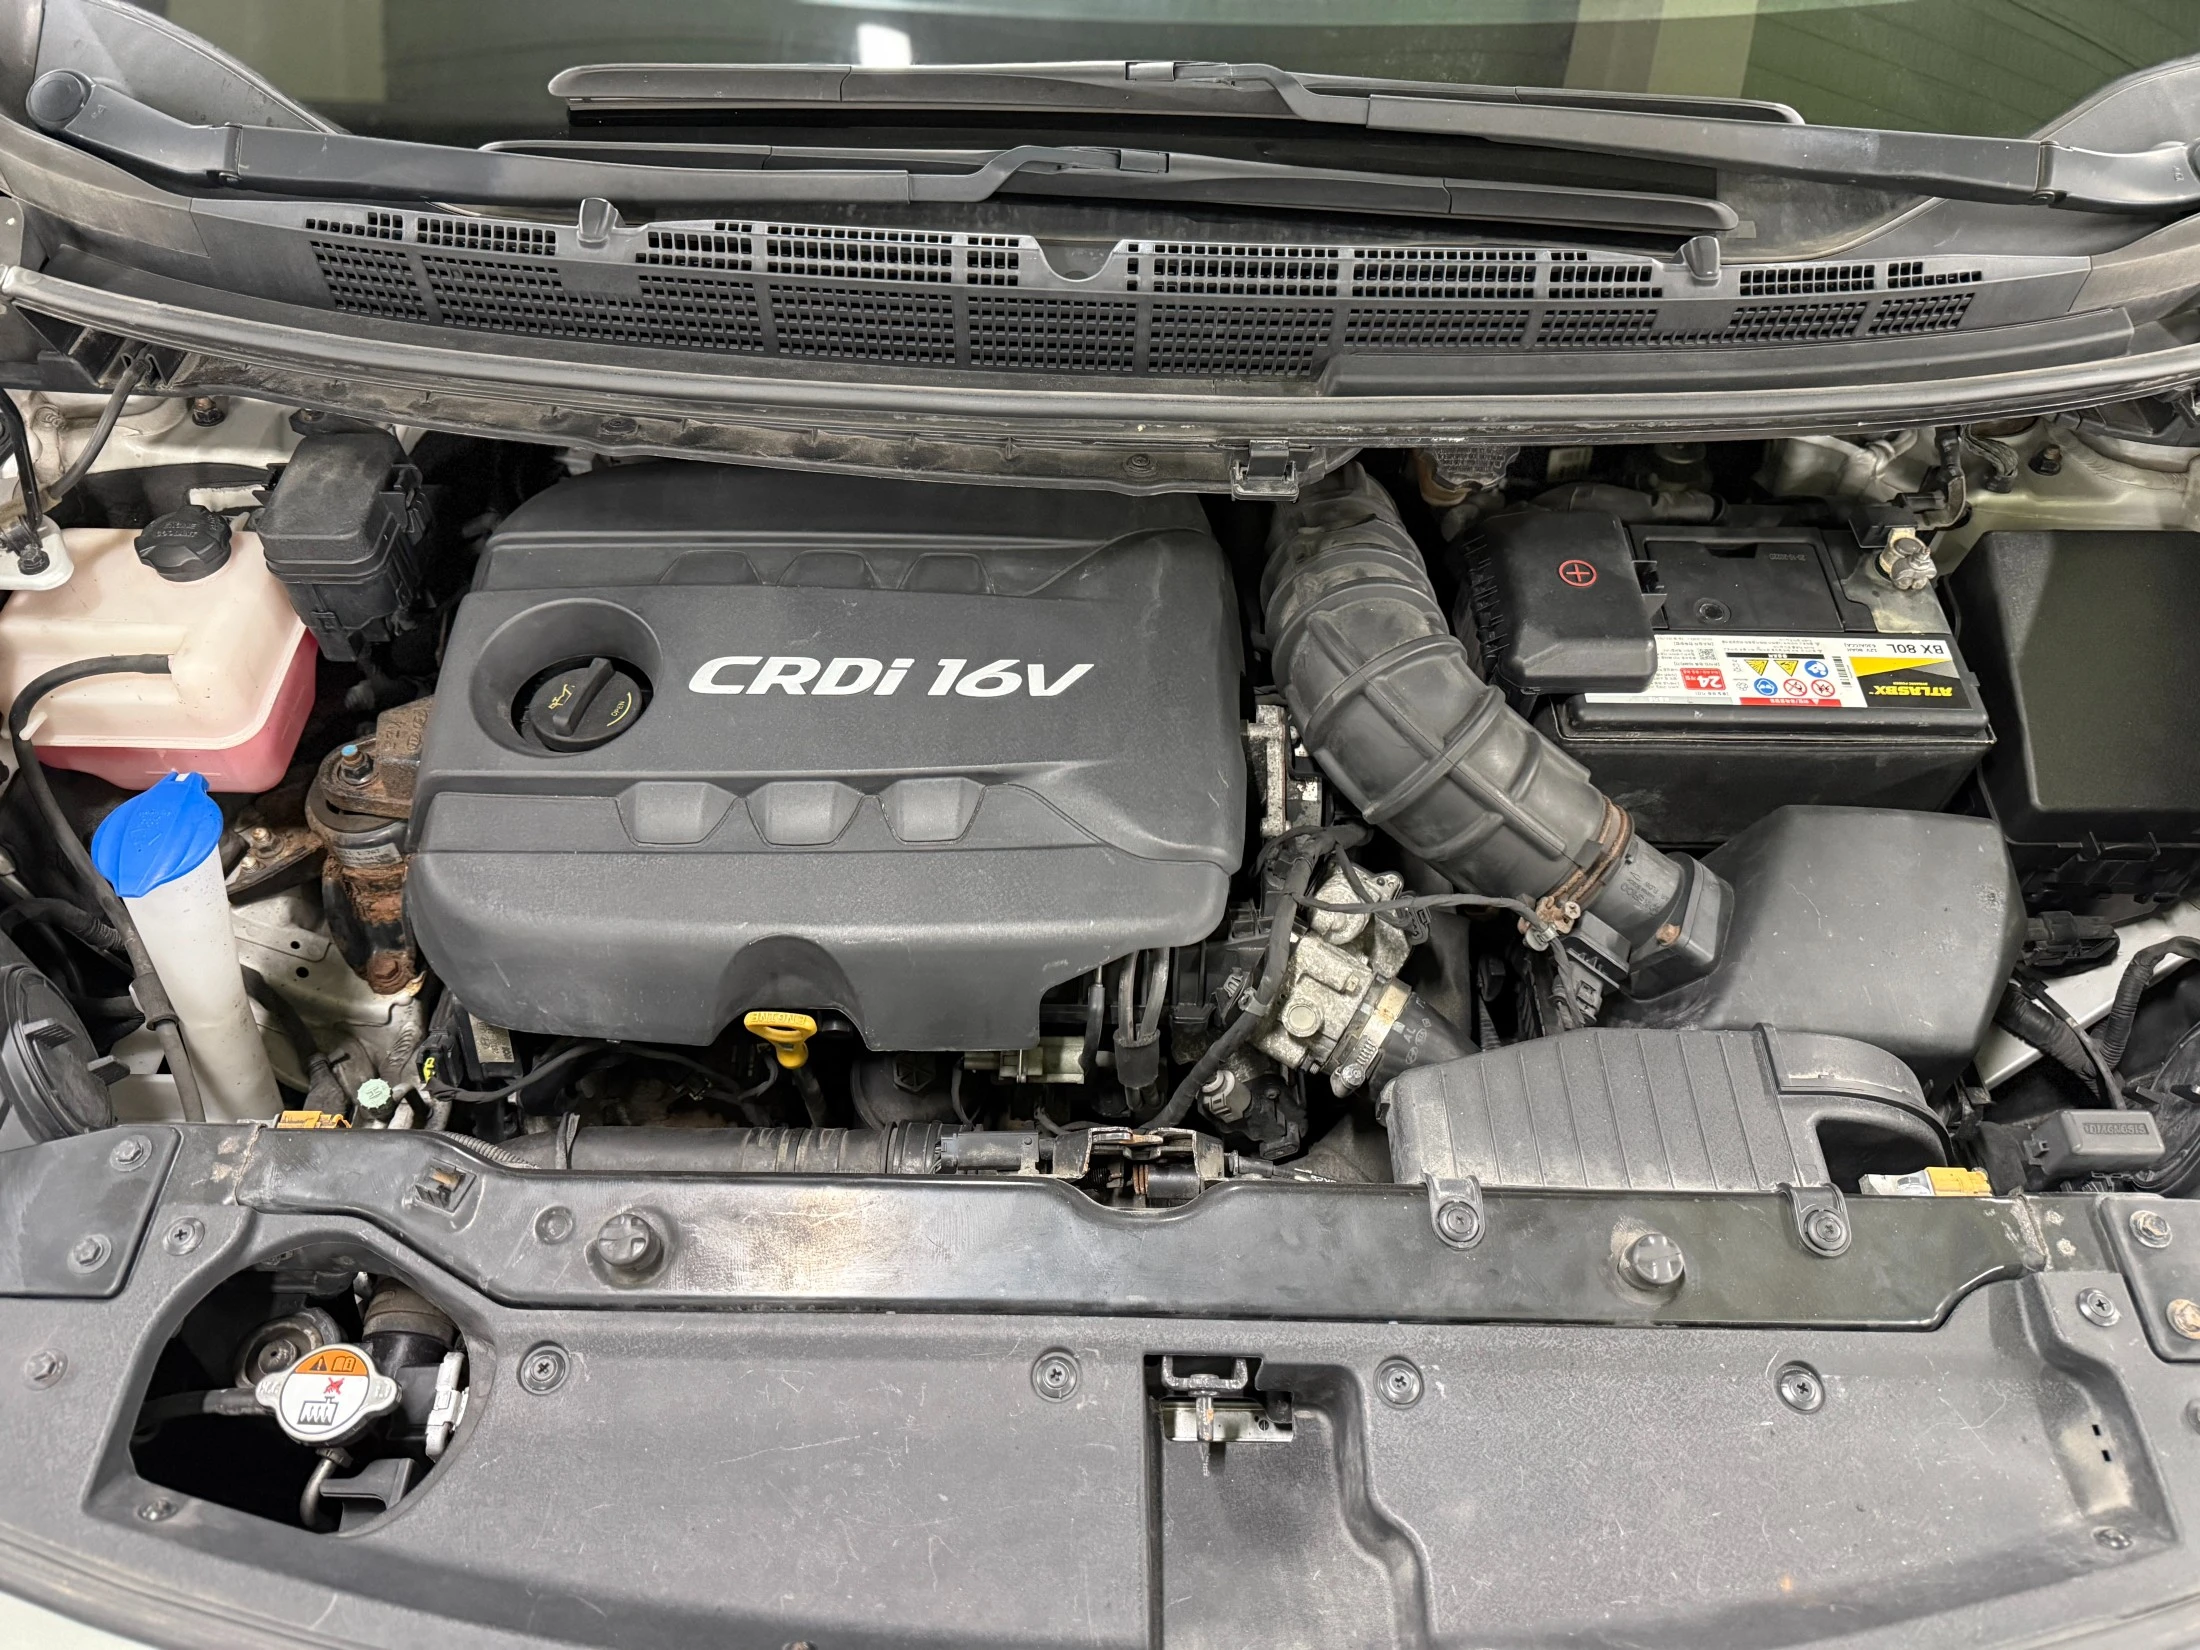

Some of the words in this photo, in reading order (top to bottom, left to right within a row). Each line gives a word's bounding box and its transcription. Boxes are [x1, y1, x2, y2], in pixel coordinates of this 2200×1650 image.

[1886, 644, 1918, 654] 80L
[1920, 644, 1945, 655] BX
[688, 656, 915, 695] CRDi
[927, 658, 1095, 697] 16V
[1873, 685, 1953, 697] ATLASBX
[610, 701, 625, 717] OPEN
[751, 1012, 807, 1025] ENGINE
[2089, 1123, 2146, 1135] DIAGNOSIS
